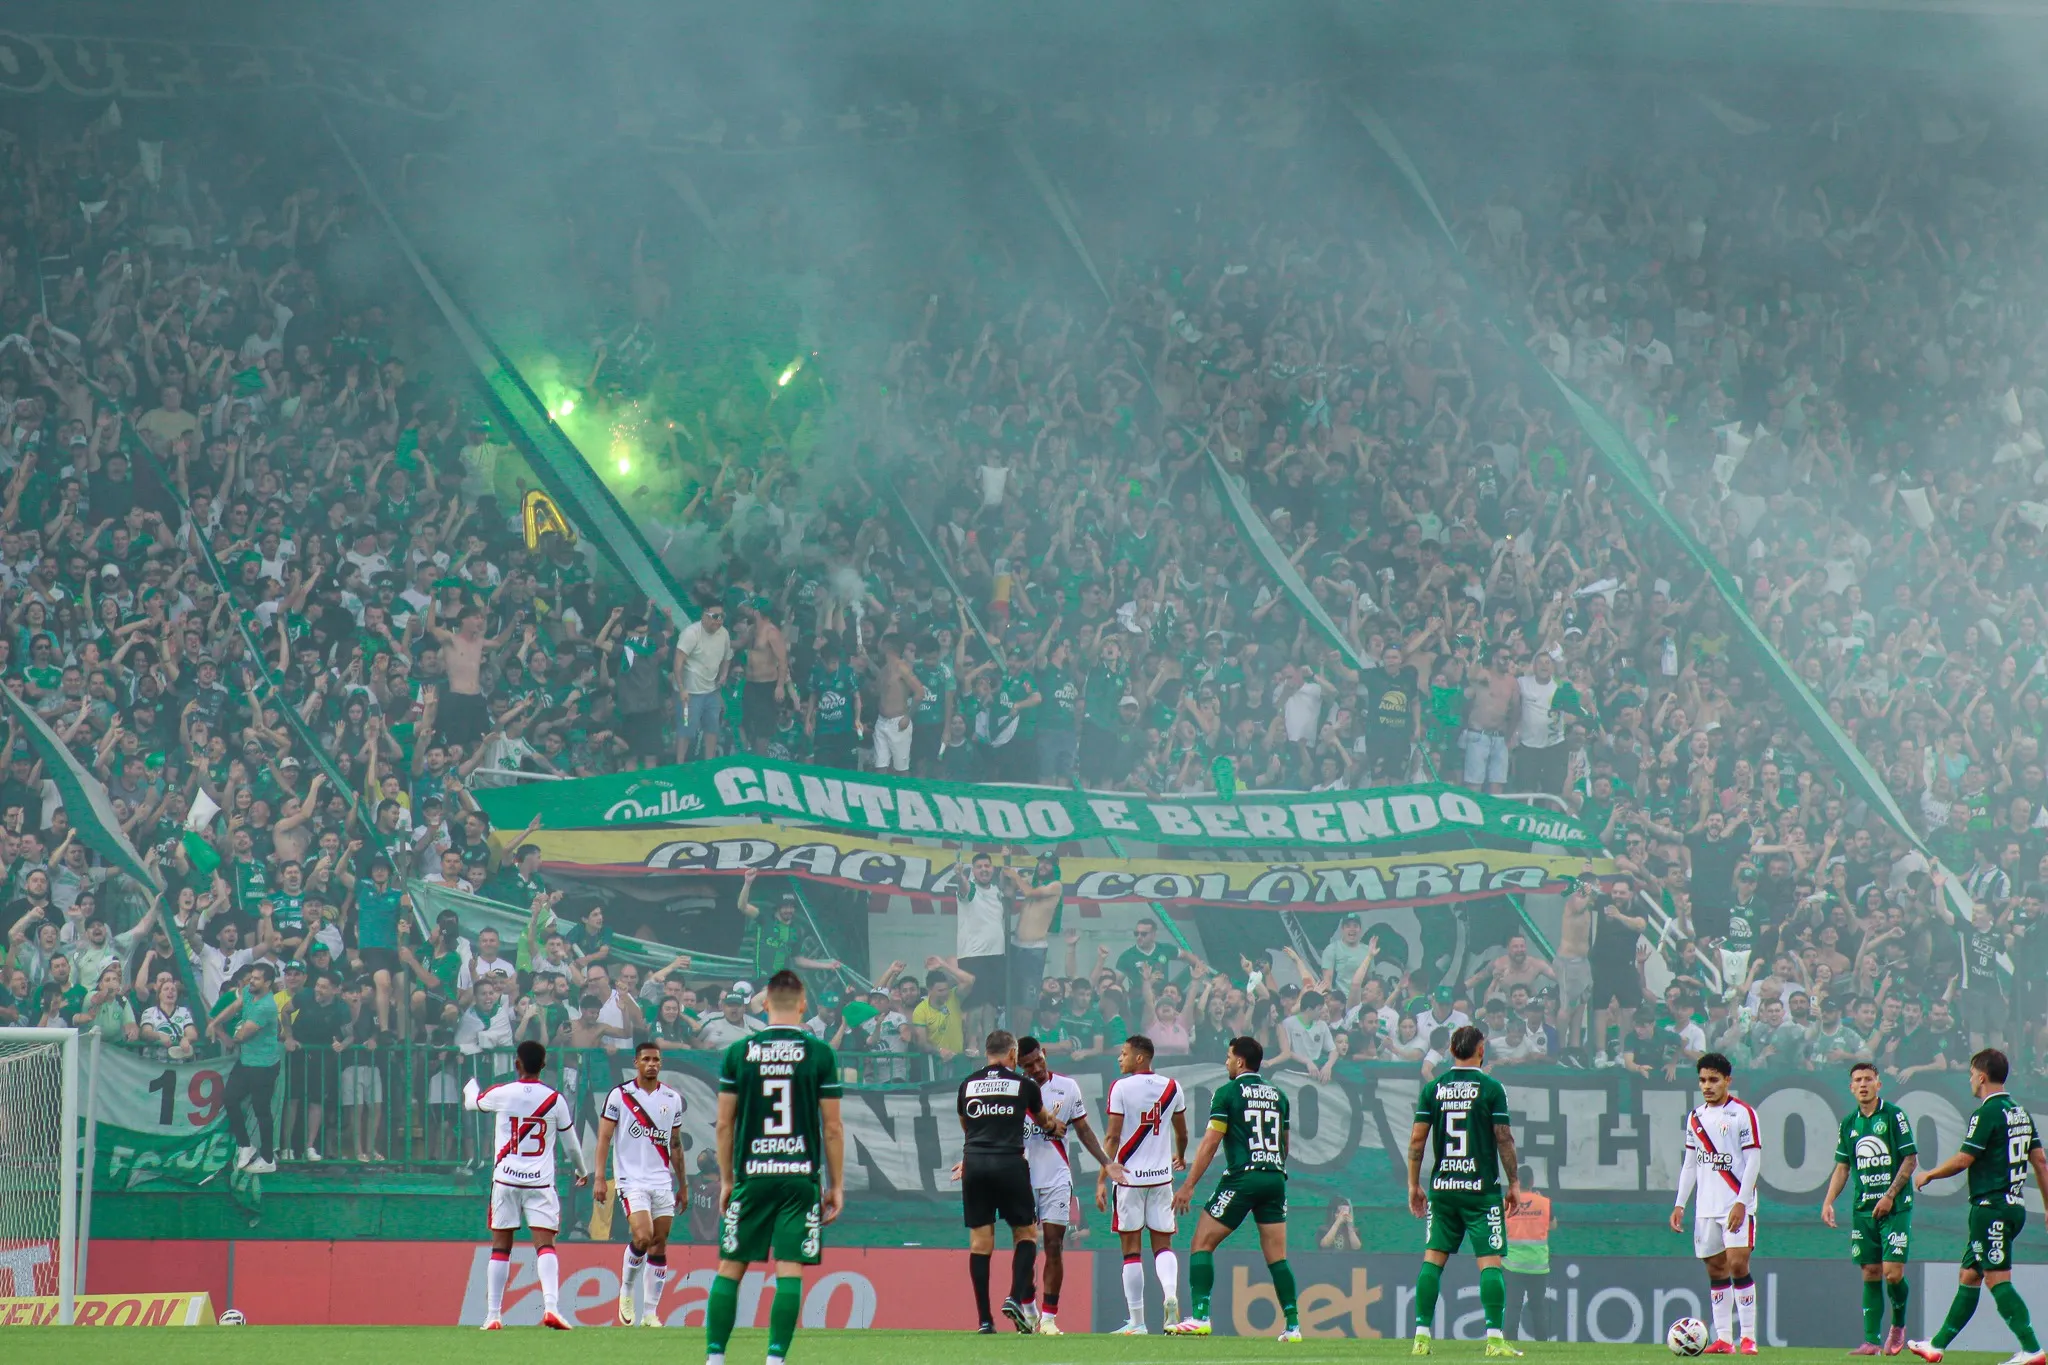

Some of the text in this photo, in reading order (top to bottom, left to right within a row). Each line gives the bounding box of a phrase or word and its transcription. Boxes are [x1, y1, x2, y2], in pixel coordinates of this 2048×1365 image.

[713, 766, 1075, 839] CANTANDO
[1087, 799, 1140, 831] E
[1146, 792, 1484, 843] BERENDO
[1077, 864, 1547, 902] COLÔMBIA
[760, 1048, 805, 1062] BUGIO
[760, 1064, 794, 1075] DOMA
[1252, 1089, 1279, 1100] BUGIO
[1447, 1088, 1479, 1099] BUGIO
[763, 1080, 792, 1135] 3
[969, 1101, 1014, 1117] Midea
[1247, 1100, 1270, 1108] BRUNO
[1440, 1101, 1472, 1110] JIMENEZ
[1141, 1102, 1162, 1136] 4
[509, 1116, 548, 1157] 13
[1244, 1110, 1280, 1151] 33
[1445, 1111, 1467, 1157] 5
[751, 1135, 806, 1155] CERAÇÁ
[1703, 1151, 1733, 1163] blaze
[1856, 1155, 1892, 1170] Aurora
[503, 1165, 541, 1179] Unimed
[745, 1159, 812, 1175] Unimed
[1135, 1167, 1169, 1178] Unimed
[1433, 1178, 1482, 1191] Unimed
[1217, 1190, 1236, 1209] alfa
[724, 1201, 742, 1235] alfa
[1488, 1206, 1501, 1235] alfa
[1988, 1220, 2004, 1248] alfa
